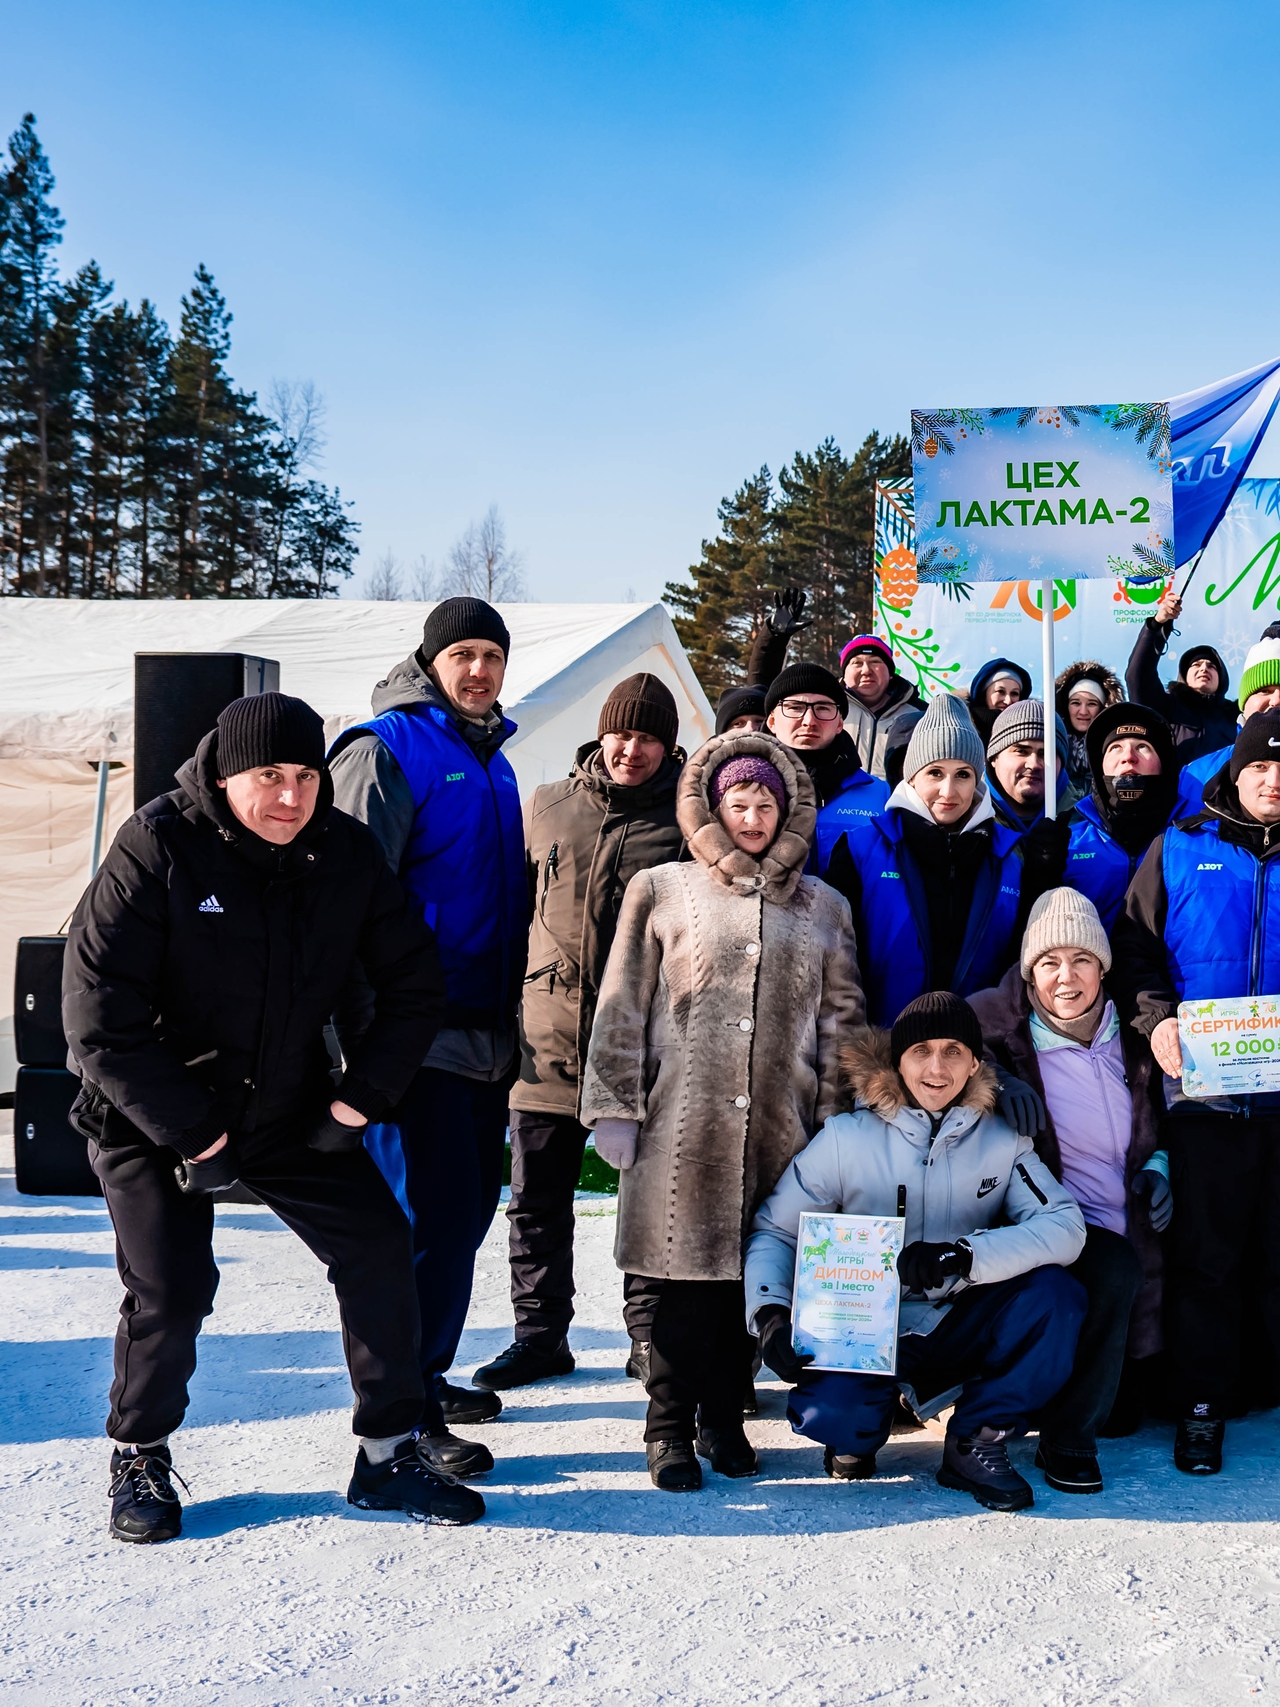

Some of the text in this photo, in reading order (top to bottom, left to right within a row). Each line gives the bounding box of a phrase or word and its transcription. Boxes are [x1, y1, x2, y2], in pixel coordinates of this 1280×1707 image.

[1006, 461, 1080, 492] ЦЕХ
[936, 497, 1150, 527] ЛАКТАМА-2
[199, 904, 224, 913] adidas
[1210, 1041, 1231, 1057] 12
[1235, 1037, 1275, 1055] 000
[980, 1176, 998, 1189] NIKE
[837, 1256, 864, 1265] ИГРЫ
[814, 1266, 884, 1282] ДИПЛОМ
[821, 1281, 833, 1290] за
[842, 1283, 875, 1292] место
[834, 1300, 871, 1309] ЛАКТАМА-2
